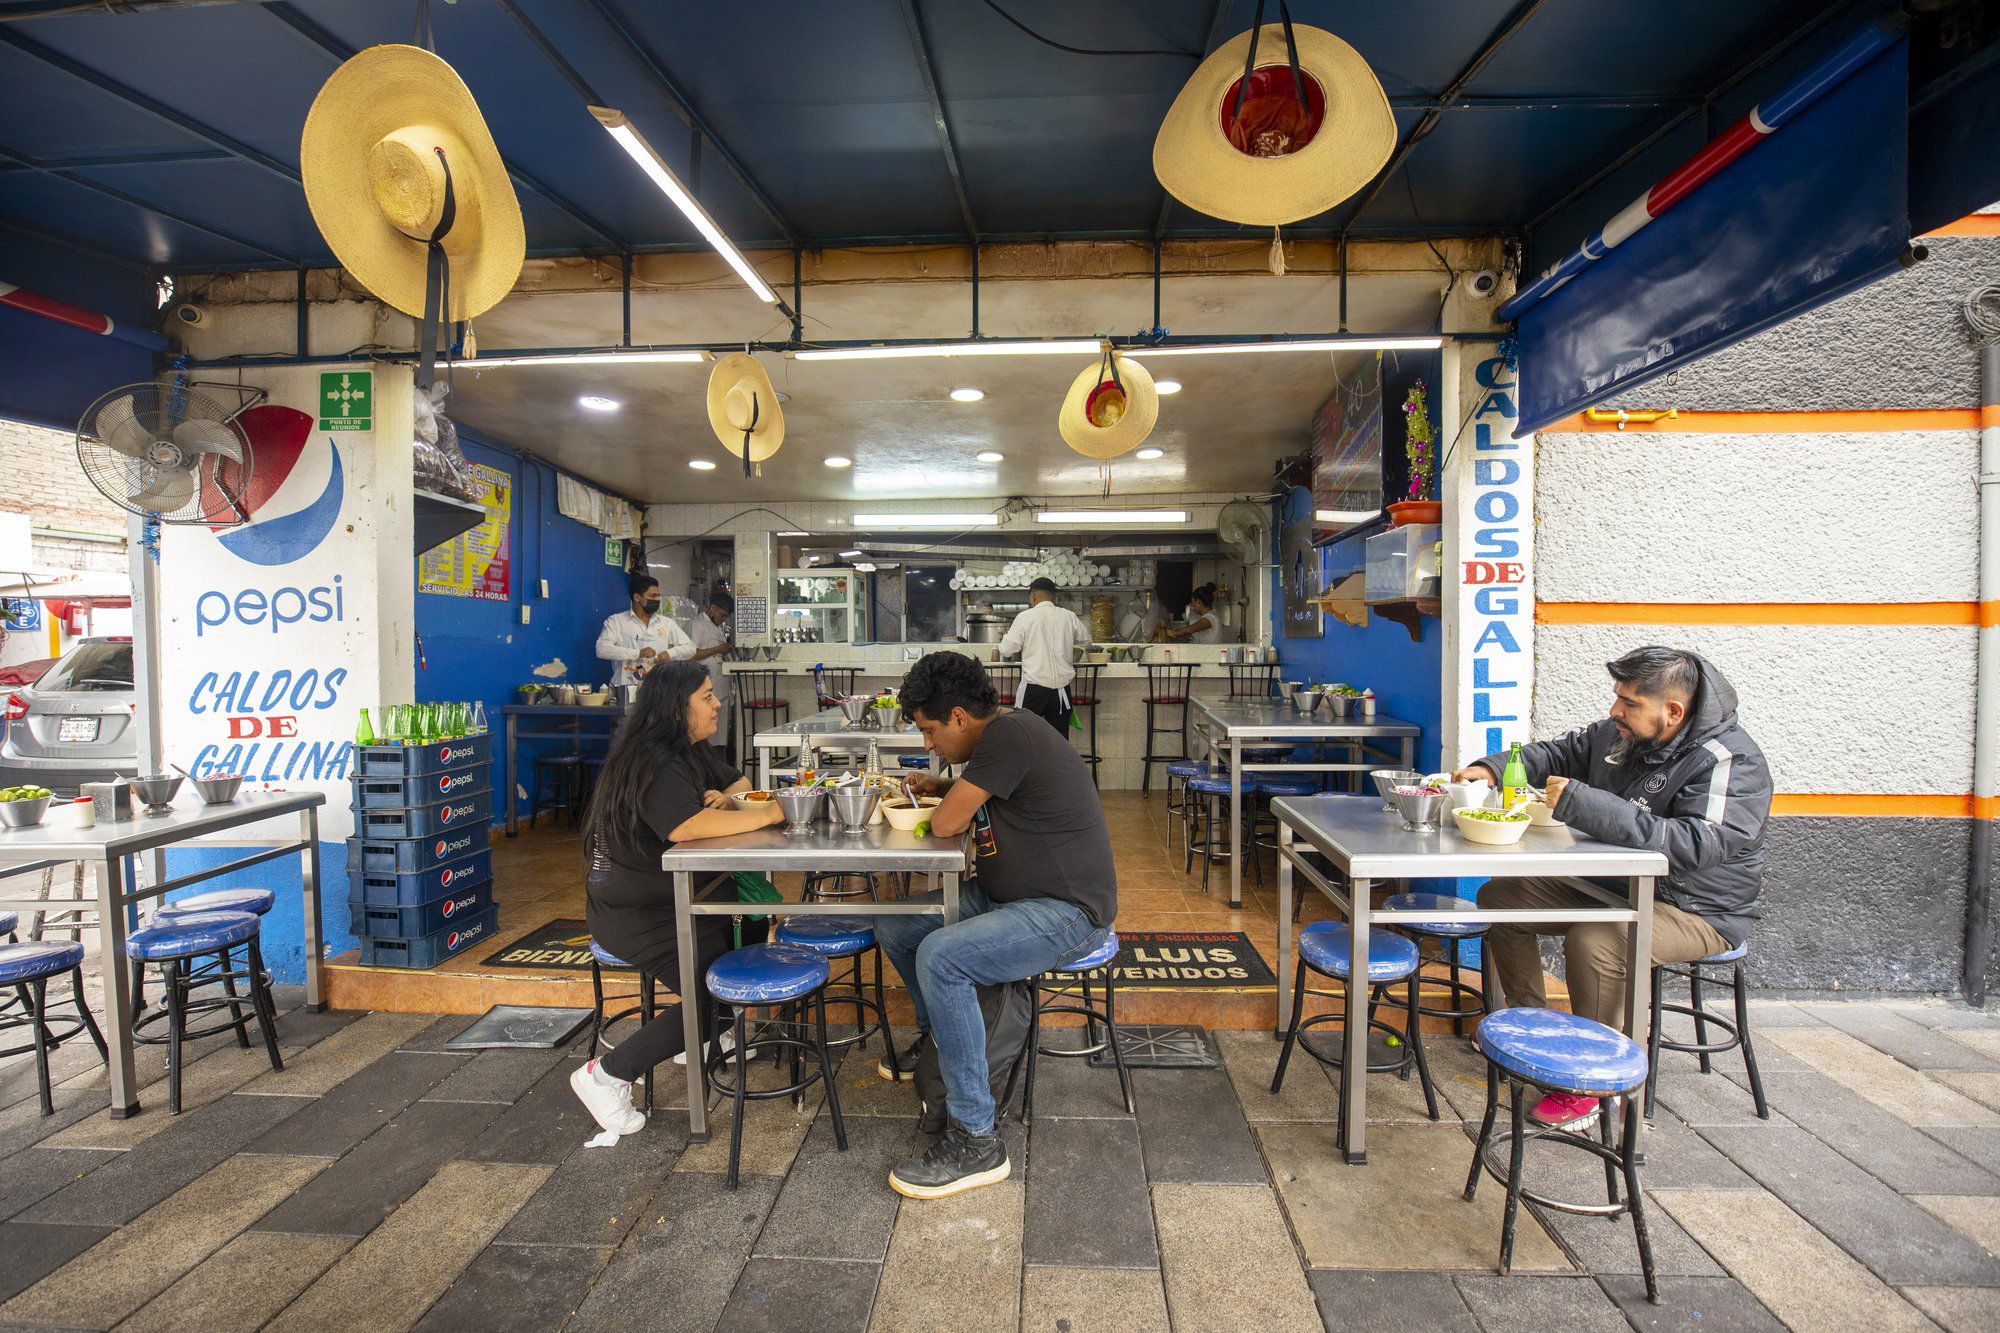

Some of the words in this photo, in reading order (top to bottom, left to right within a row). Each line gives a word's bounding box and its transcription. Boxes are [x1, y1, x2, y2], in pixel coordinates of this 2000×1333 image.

[1474, 357, 1520, 558] CALDOS
[1462, 562, 1526, 584] DE
[421, 583, 458, 595] SERVICIO
[460, 588, 474, 597] LAS
[475, 590, 483, 598] 24
[485, 592, 508, 601] HORAS
[196, 574, 343, 637] pepsi
[189, 667, 348, 714] CALDOS
[227, 716, 298, 739] DE
[189, 741, 353, 782] GALLINA
[452, 746, 474, 760] pepsi
[451, 772, 473, 788] pepsi
[453, 803, 475, 819] pepsi
[448, 836, 471, 853] pepsi
[454, 865, 475, 881] pepsi
[456, 895, 476, 911] pepsi
[460, 922, 482, 943] pepsi
[1134, 947, 1237, 962] LUIS
